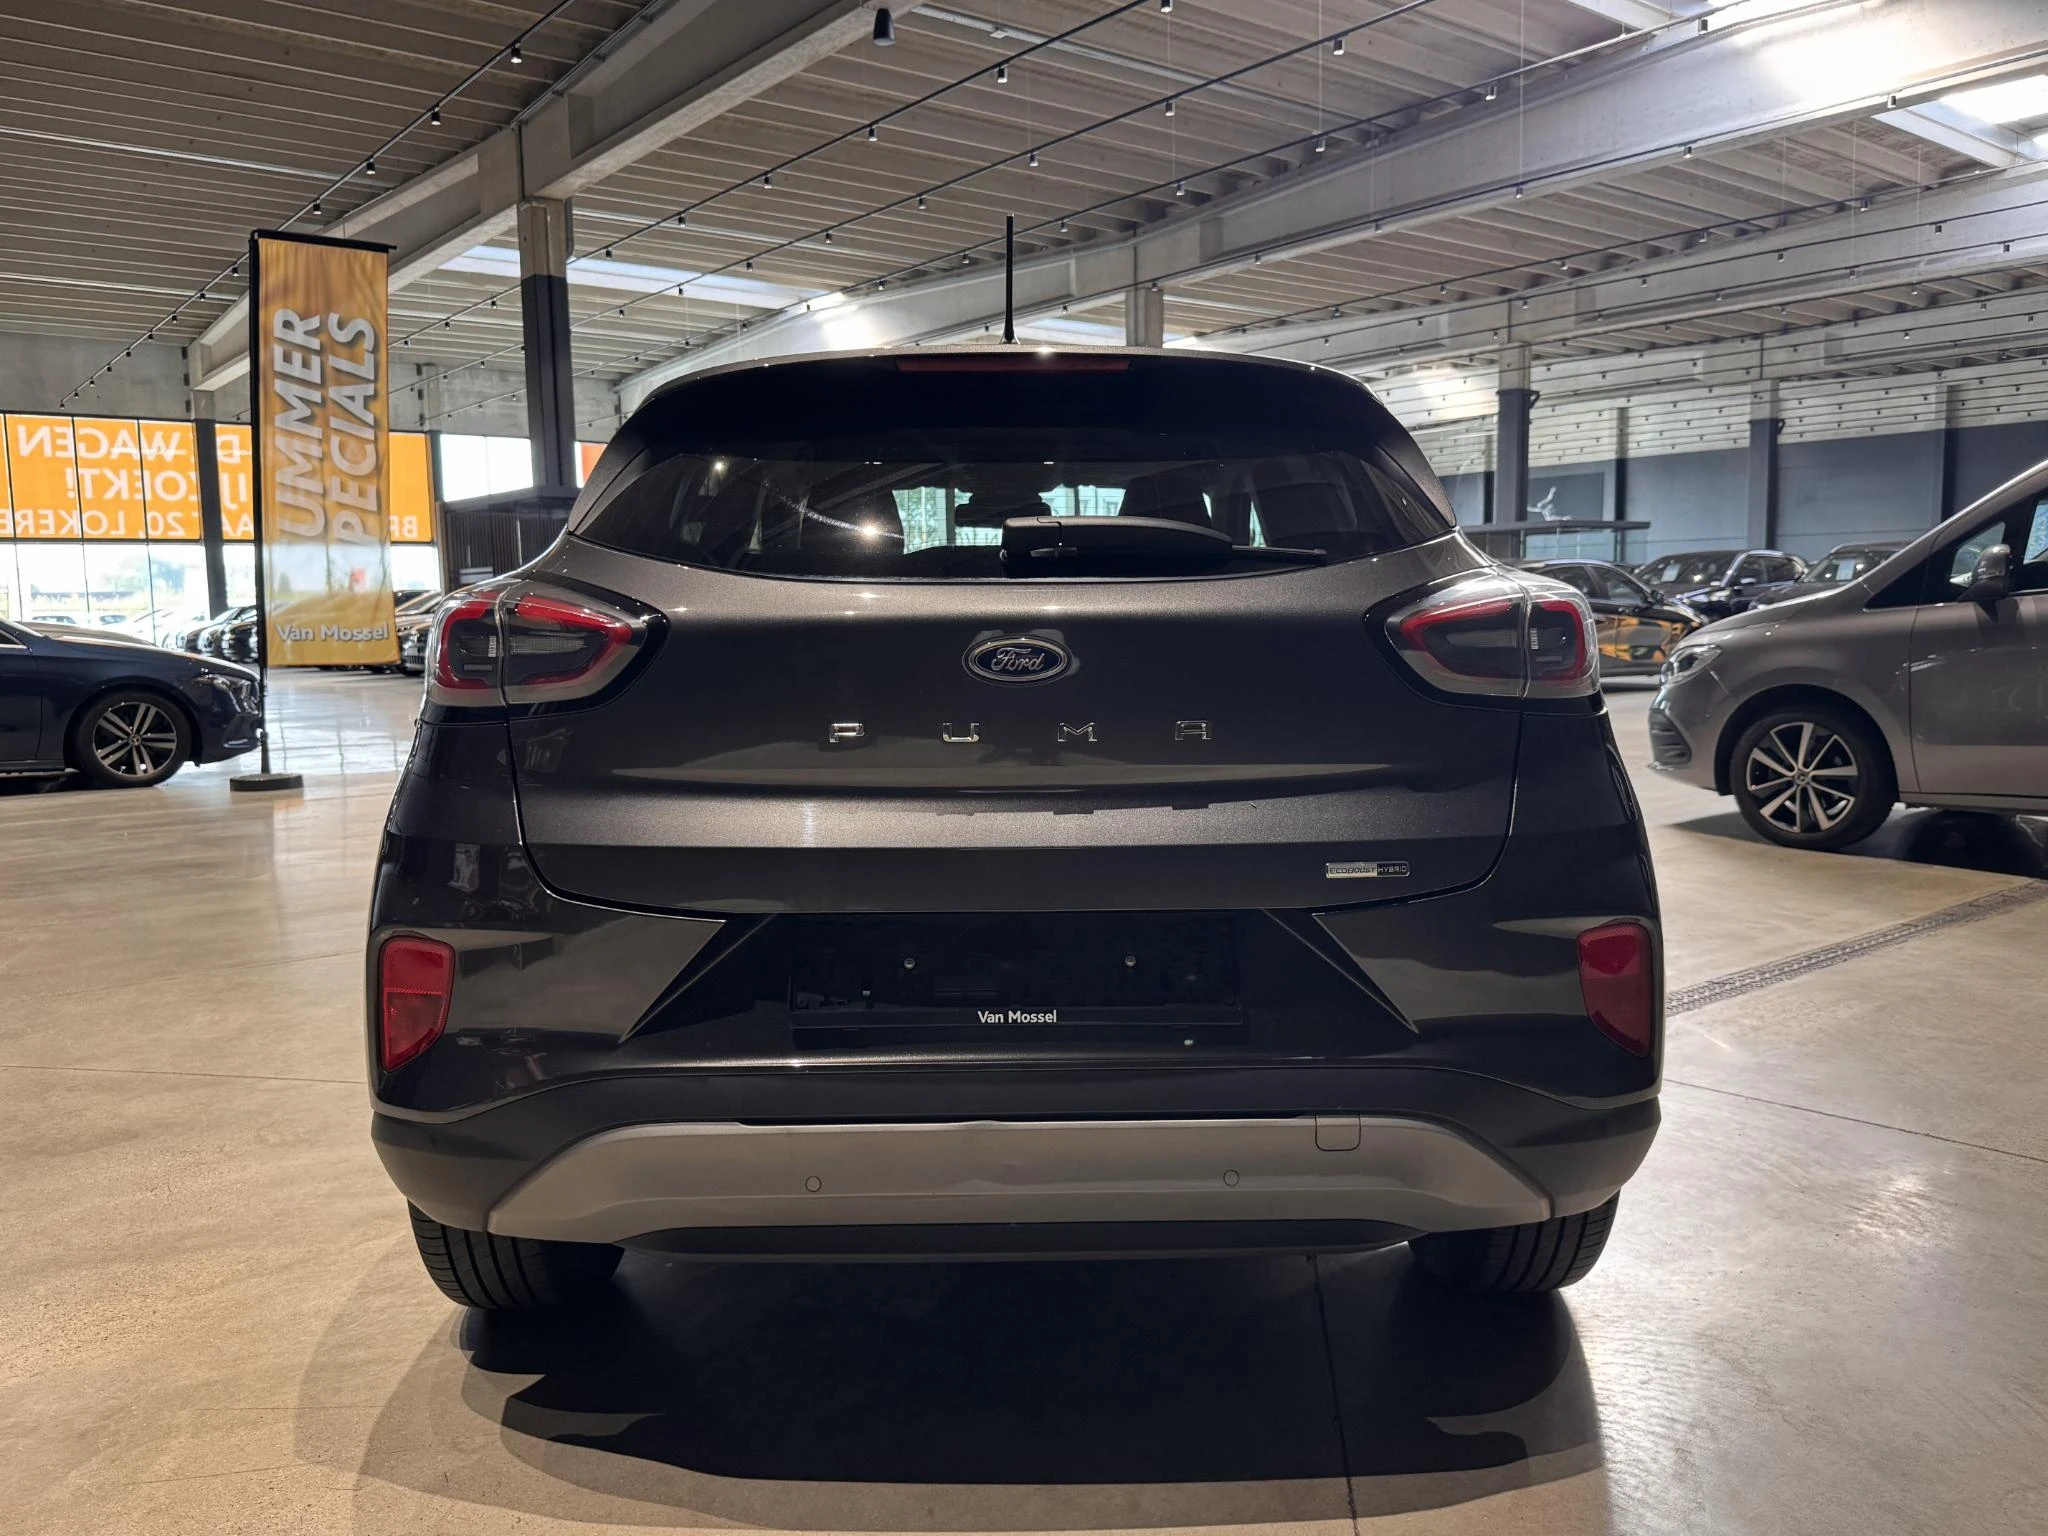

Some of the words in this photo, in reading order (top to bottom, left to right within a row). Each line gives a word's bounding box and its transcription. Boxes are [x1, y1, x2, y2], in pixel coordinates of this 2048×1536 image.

[273, 308, 326, 539] UMMER
[327, 311, 379, 545] PECIALS
[275, 623, 315, 641] Van
[320, 622, 389, 641] Mossel
[990, 646, 1045, 671] Ford
[828, 719, 1213, 744] PUMA
[1377, 865, 1407, 874] HYBRID
[977, 1010, 1004, 1024] Van
[1008, 1009, 1057, 1023] Mossel
